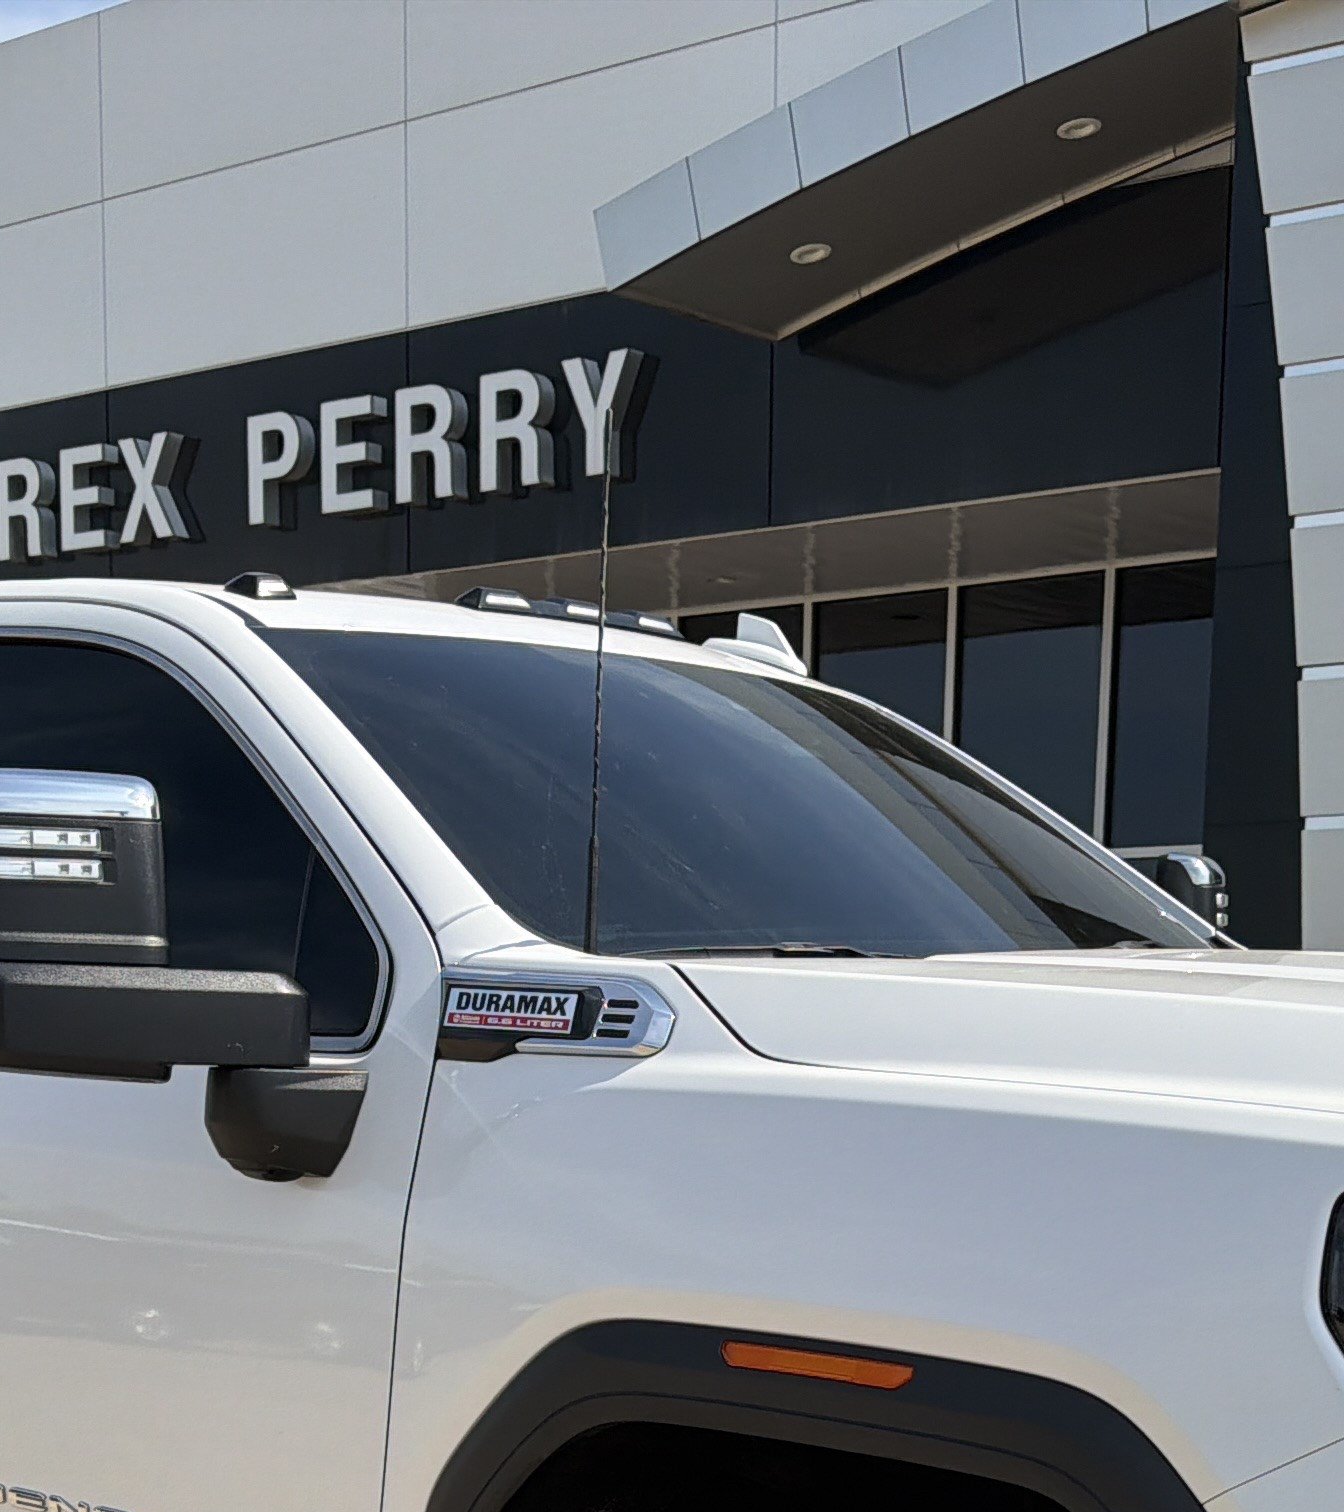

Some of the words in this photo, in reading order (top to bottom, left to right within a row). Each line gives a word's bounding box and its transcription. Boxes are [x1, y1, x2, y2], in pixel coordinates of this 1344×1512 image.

[247, 348, 644, 526] PERRY
[456, 992, 569, 1016] DURAMAX
[516, 1018, 564, 1029] LITER
